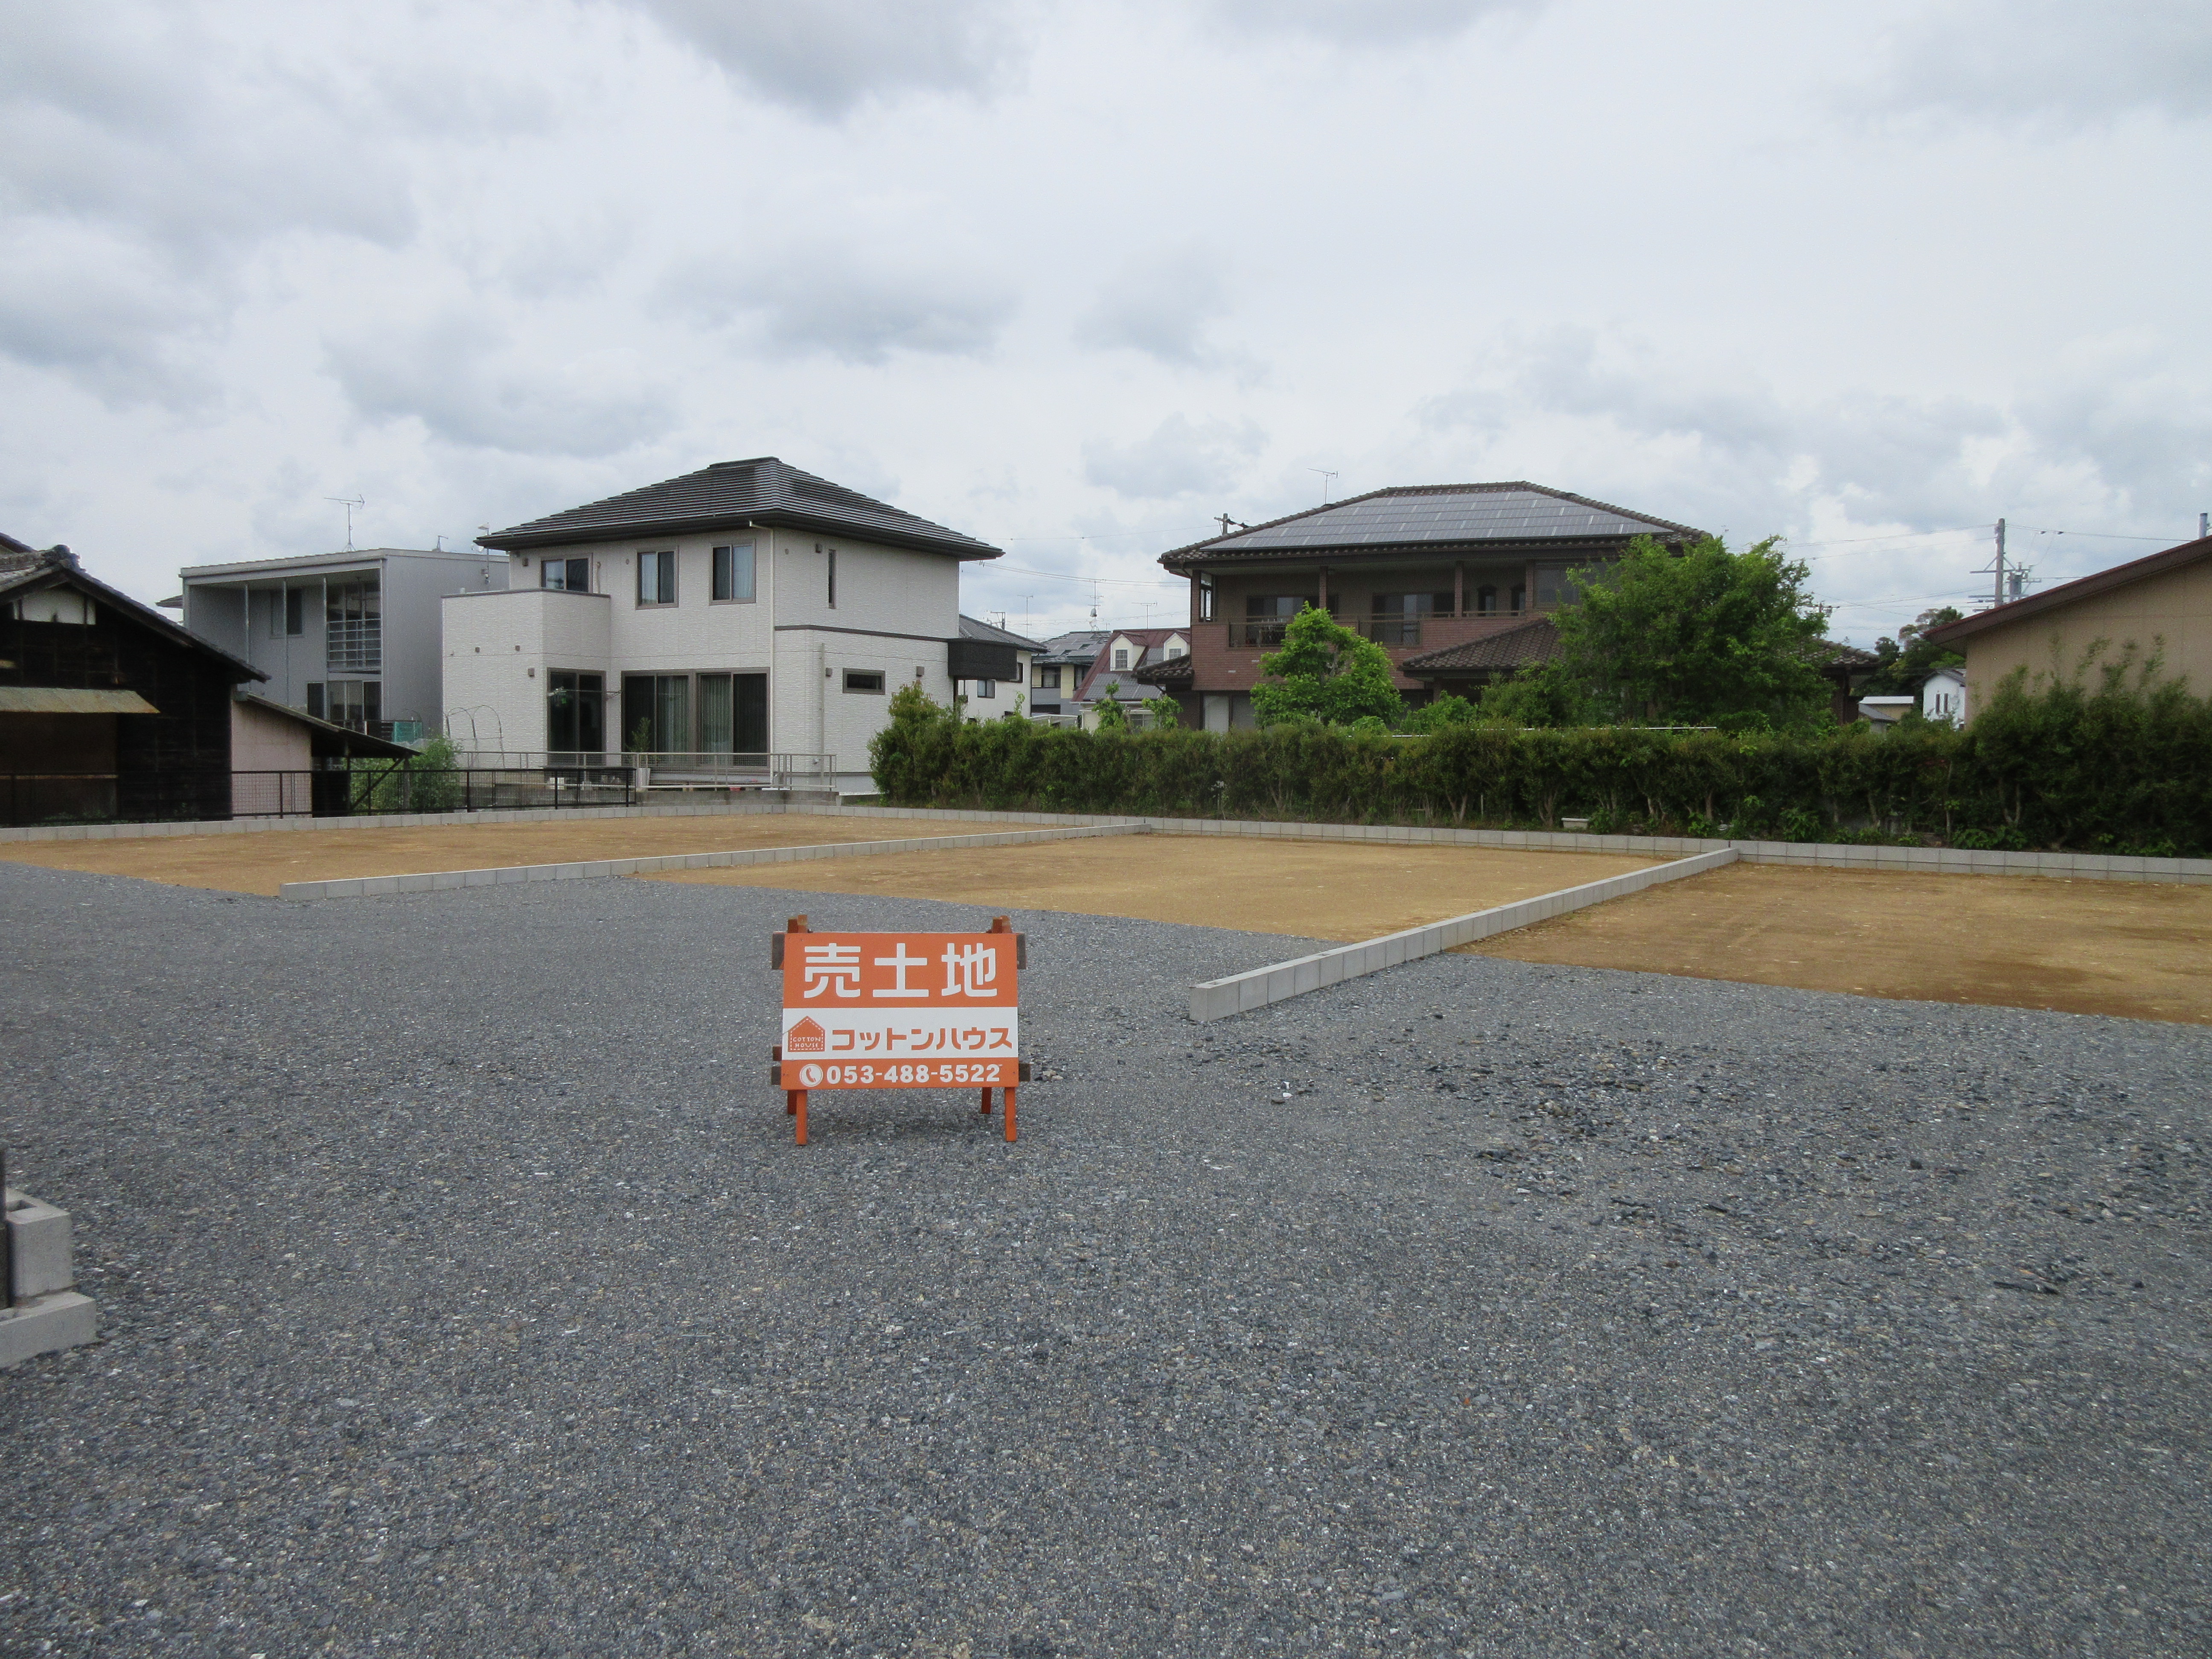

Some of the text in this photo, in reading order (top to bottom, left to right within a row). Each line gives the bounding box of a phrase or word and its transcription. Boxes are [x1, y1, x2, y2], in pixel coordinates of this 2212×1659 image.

[803, 943, 997, 998] 売土地
[832, 1026, 1013, 1051] コットンハウス
[826, 1064, 1000, 1083] 053-488-5522
